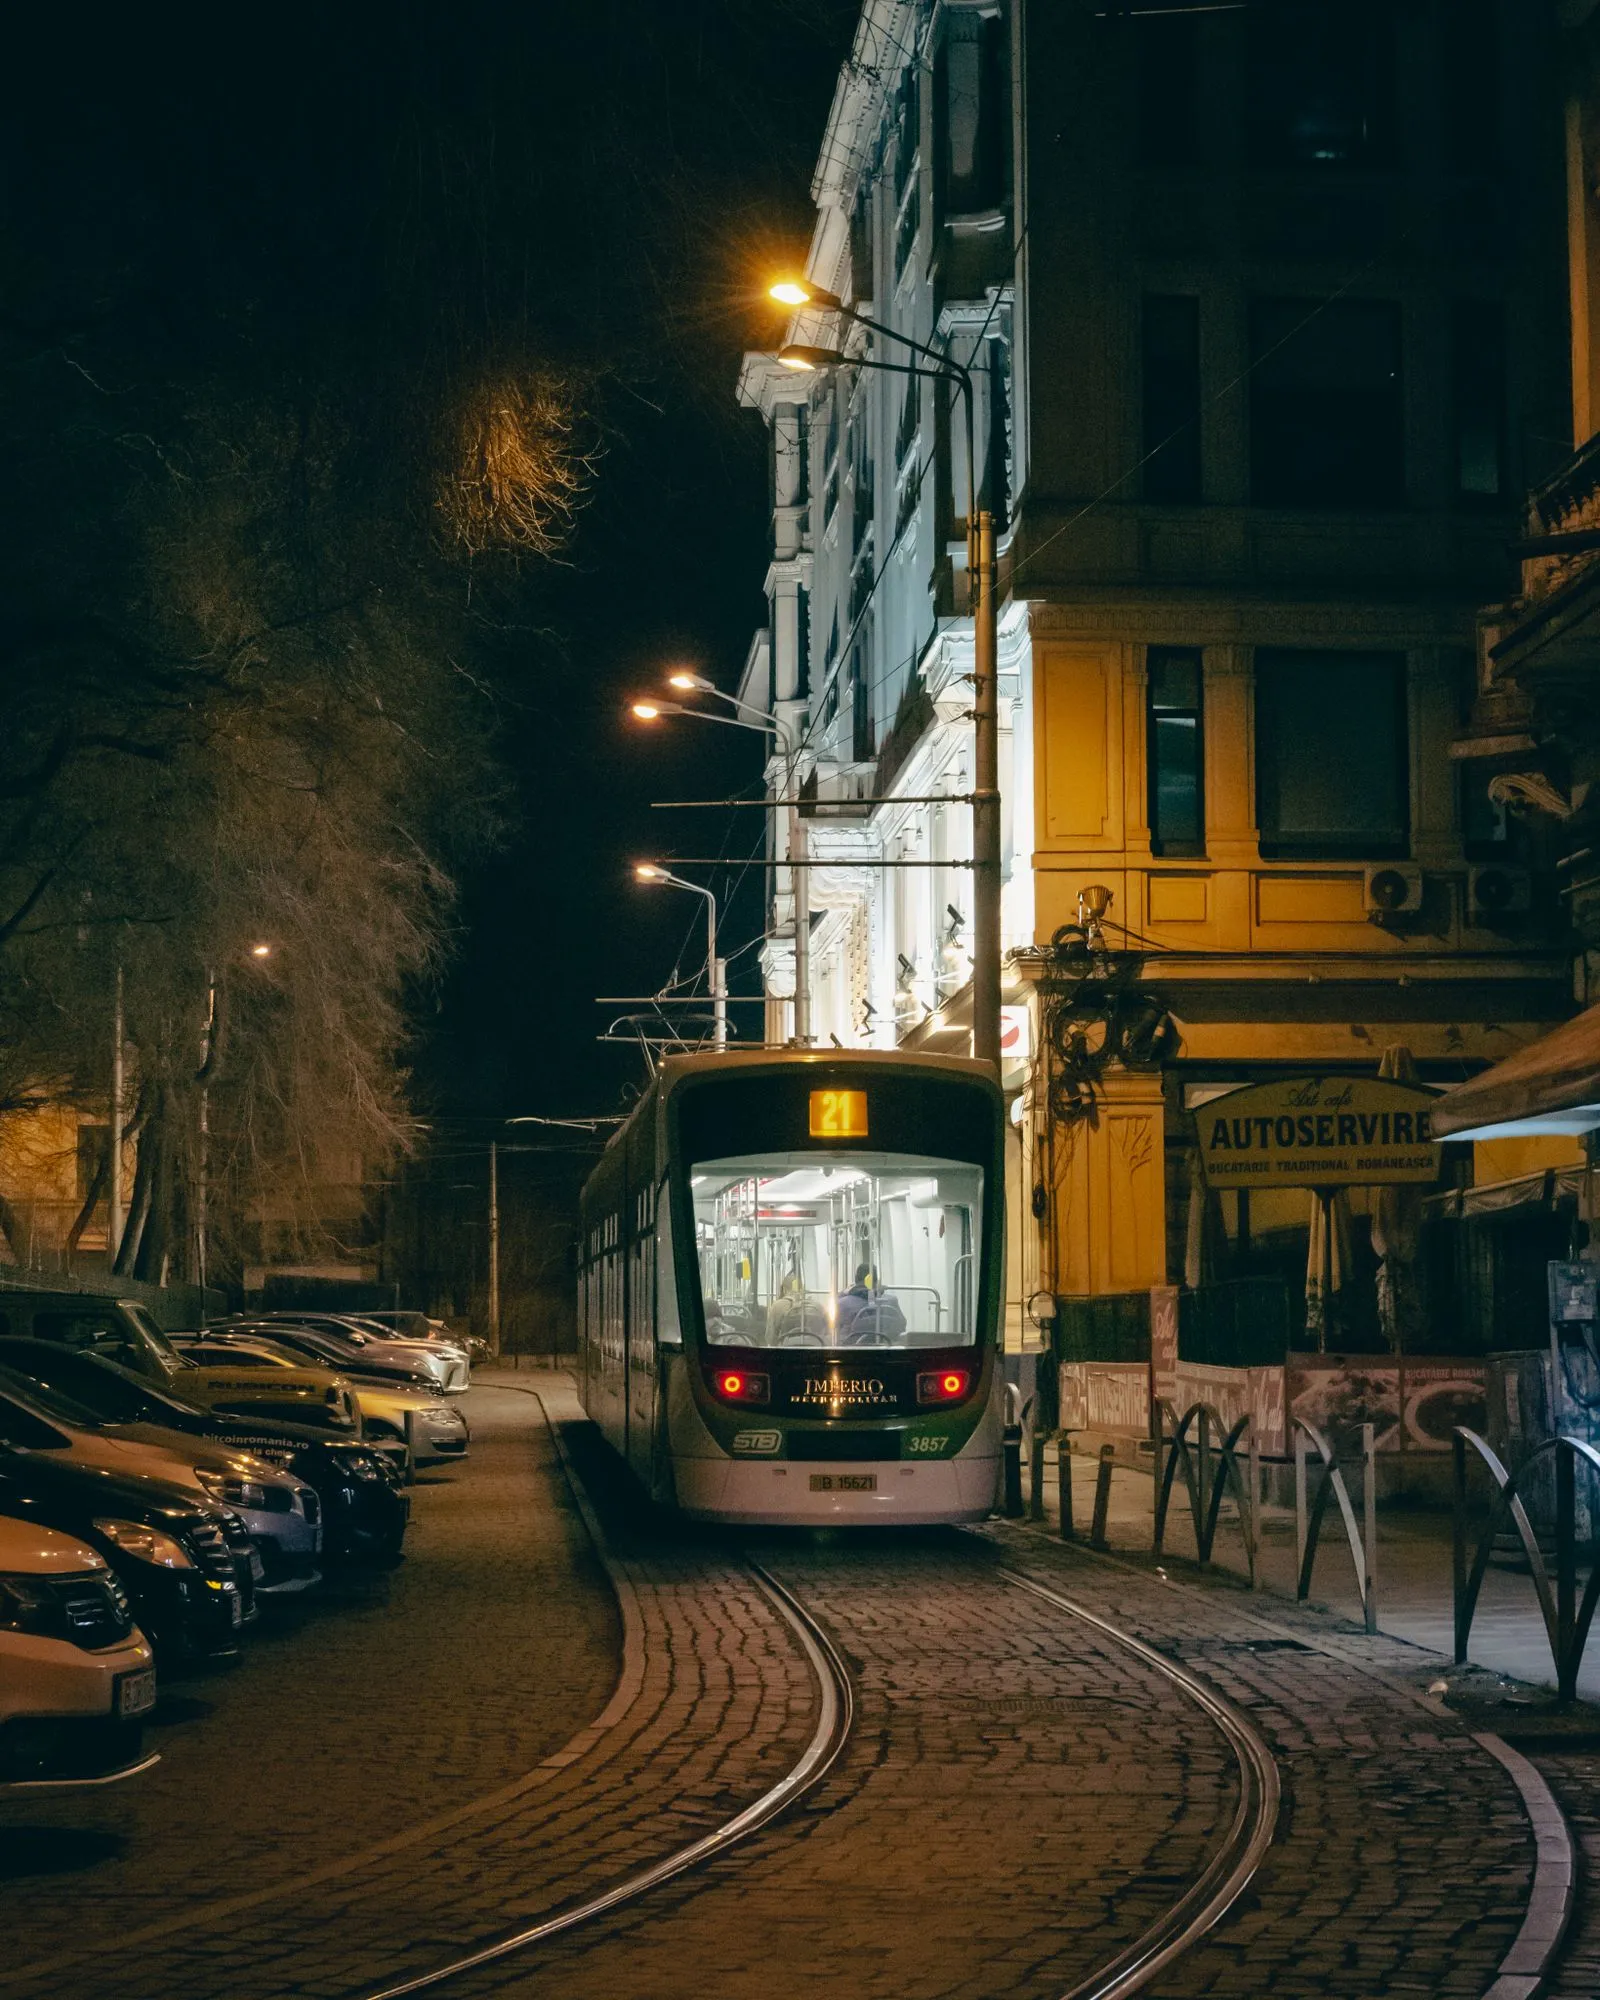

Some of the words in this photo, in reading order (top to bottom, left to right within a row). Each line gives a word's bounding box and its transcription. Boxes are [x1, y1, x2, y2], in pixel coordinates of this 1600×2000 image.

[822, 1091, 850, 1131] 21
[1210, 1112, 1433, 1149] AUTOSERVIRE
[804, 1379, 884, 1395] IMPERIO
[790, 1395, 897, 1404] METROPOLITAN
[202, 1433, 309, 1450] bitcoinromania.ro
[733, 1433, 778, 1450] STB
[910, 1436, 949, 1451] 3857
[822, 1477, 832, 1489] B
